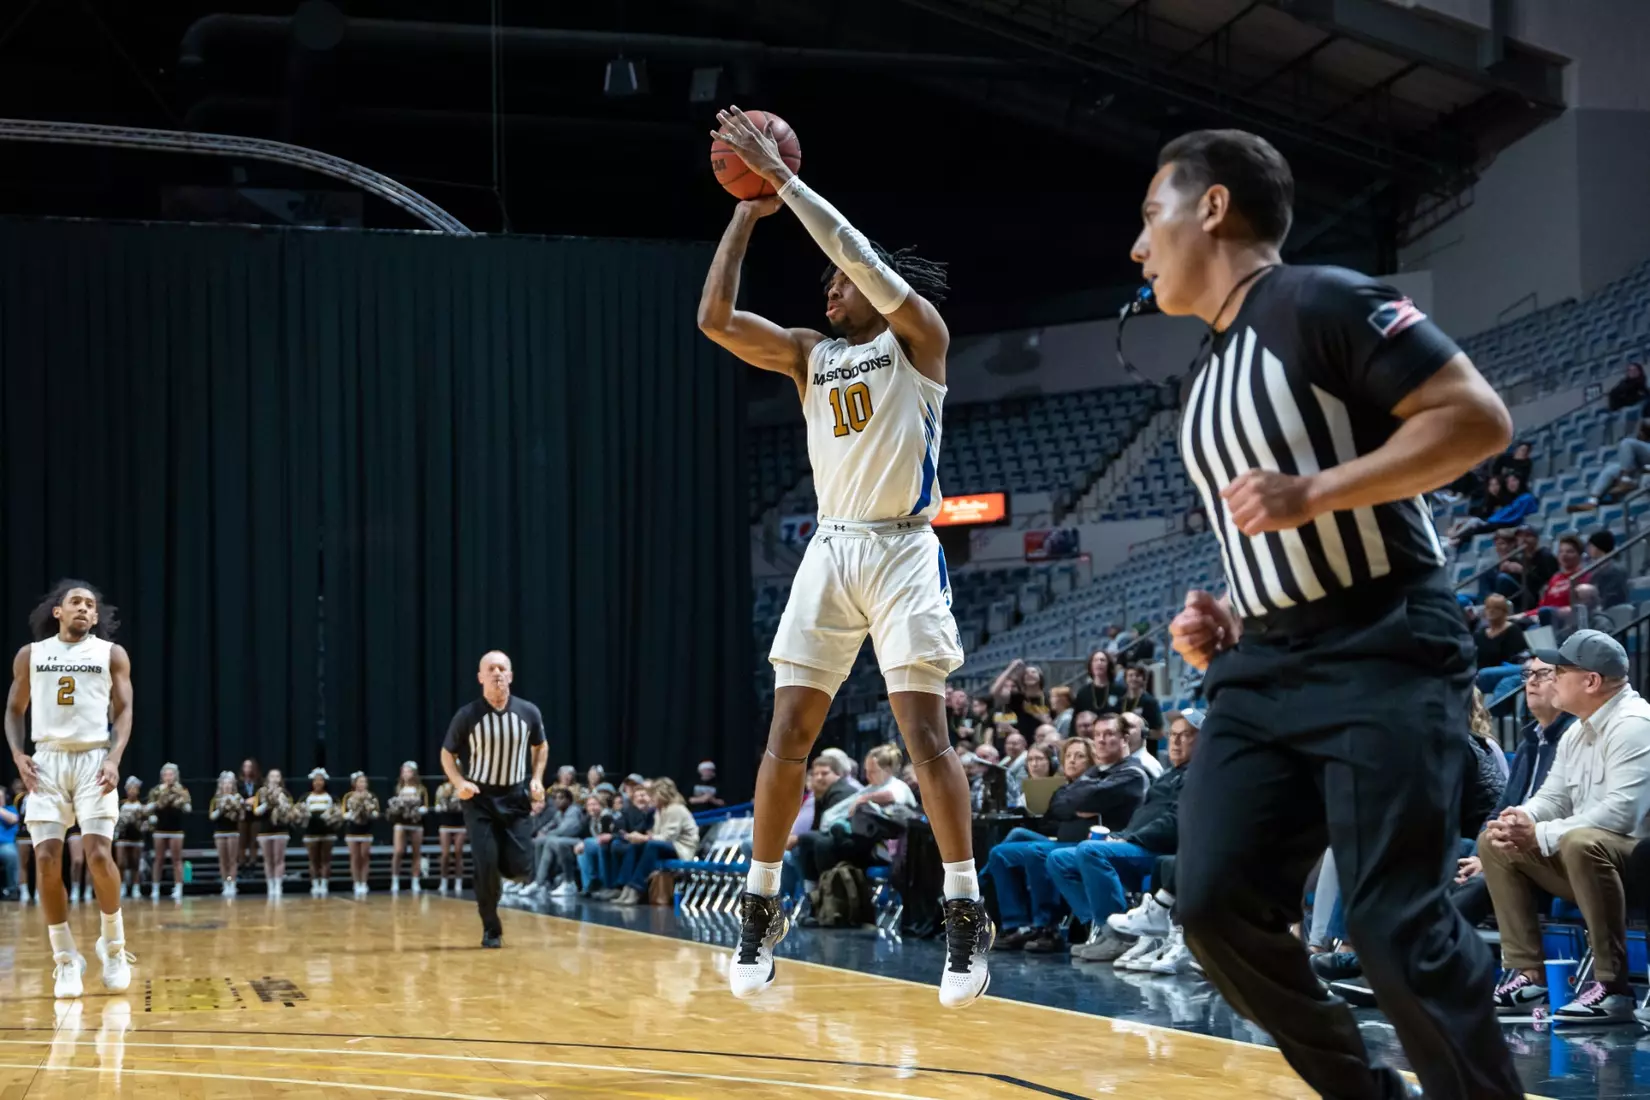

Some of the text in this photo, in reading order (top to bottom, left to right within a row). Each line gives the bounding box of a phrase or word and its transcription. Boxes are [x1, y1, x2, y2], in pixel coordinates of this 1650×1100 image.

[813, 355, 891, 386] MSTODONS
[829, 382, 874, 437] 10
[36, 665, 103, 674] MASTODONS
[57, 676, 76, 706] 2
